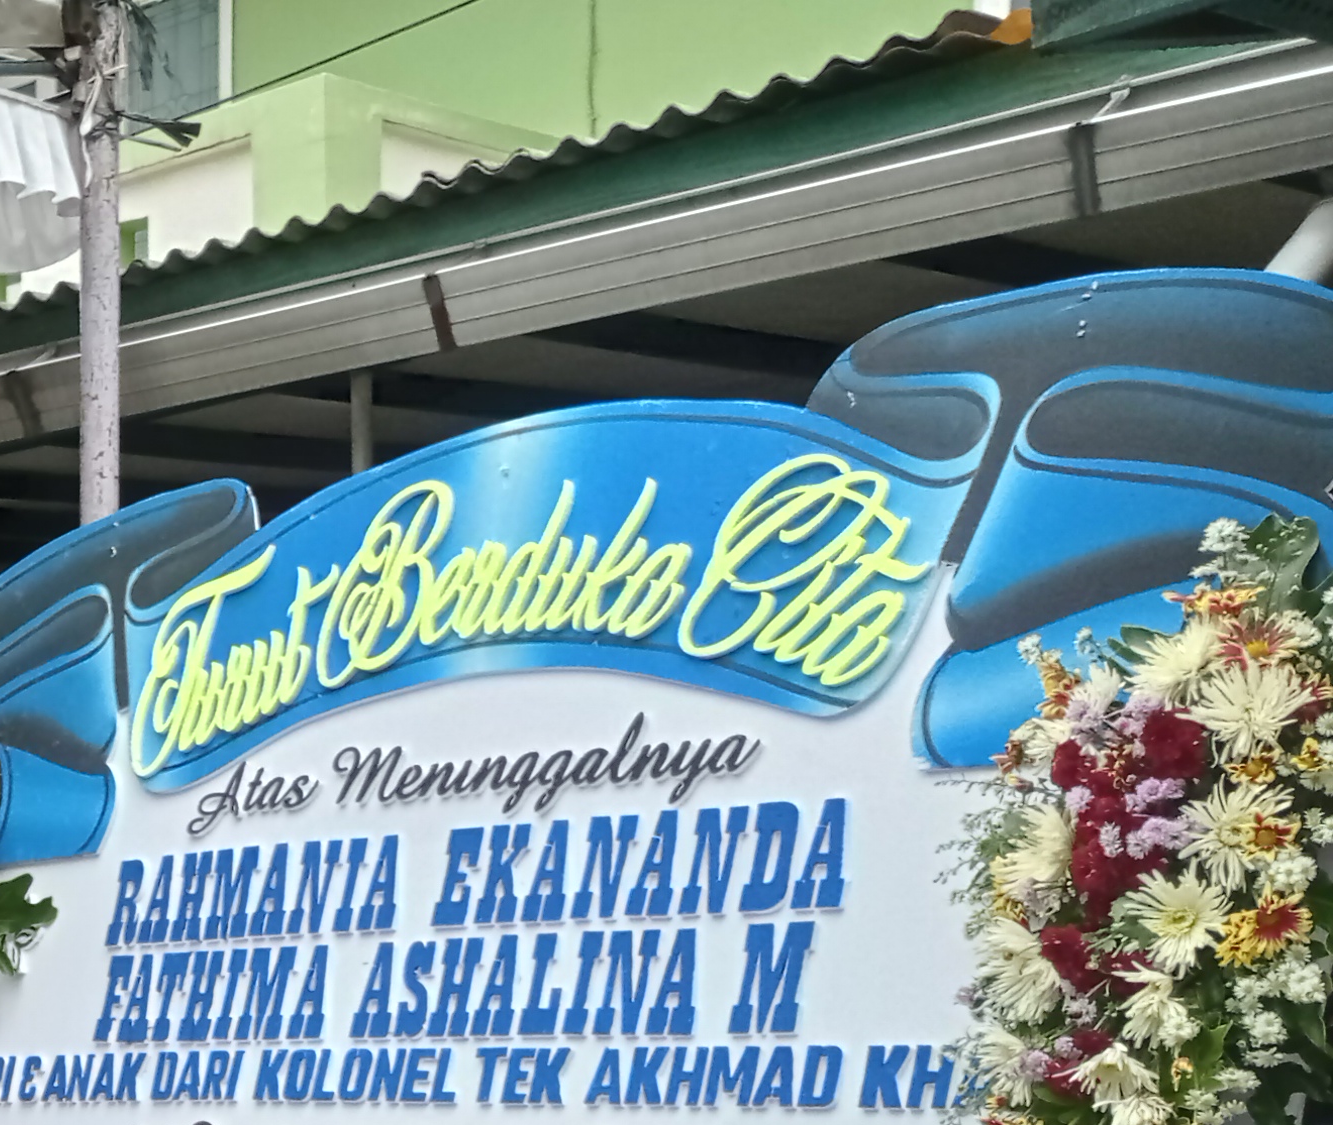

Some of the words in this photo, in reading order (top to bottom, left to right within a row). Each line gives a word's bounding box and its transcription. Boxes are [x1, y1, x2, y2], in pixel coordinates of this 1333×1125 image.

[132, 544, 337, 777] Turut
[318, 478, 692, 688] Berduka
[677, 454, 930, 687] Cita
[186, 761, 319, 836] Atas
[333, 712, 763, 814] Meninggalnya
[105, 834, 399, 947] RAHMANIA
[430, 798, 847, 926] EKANANDA
[93, 944, 330, 1042] FATHIMA
[349, 928, 698, 1038] ASHALINA
[728, 920, 816, 1035] M
[41, 1052, 145, 1102] ANAK
[149, 1050, 245, 1102] DARI
[252, 1047, 457, 1102] KOLONEL
[477, 1047, 572, 1106] TEK
[583, 1045, 844, 1110] AKHMAD
